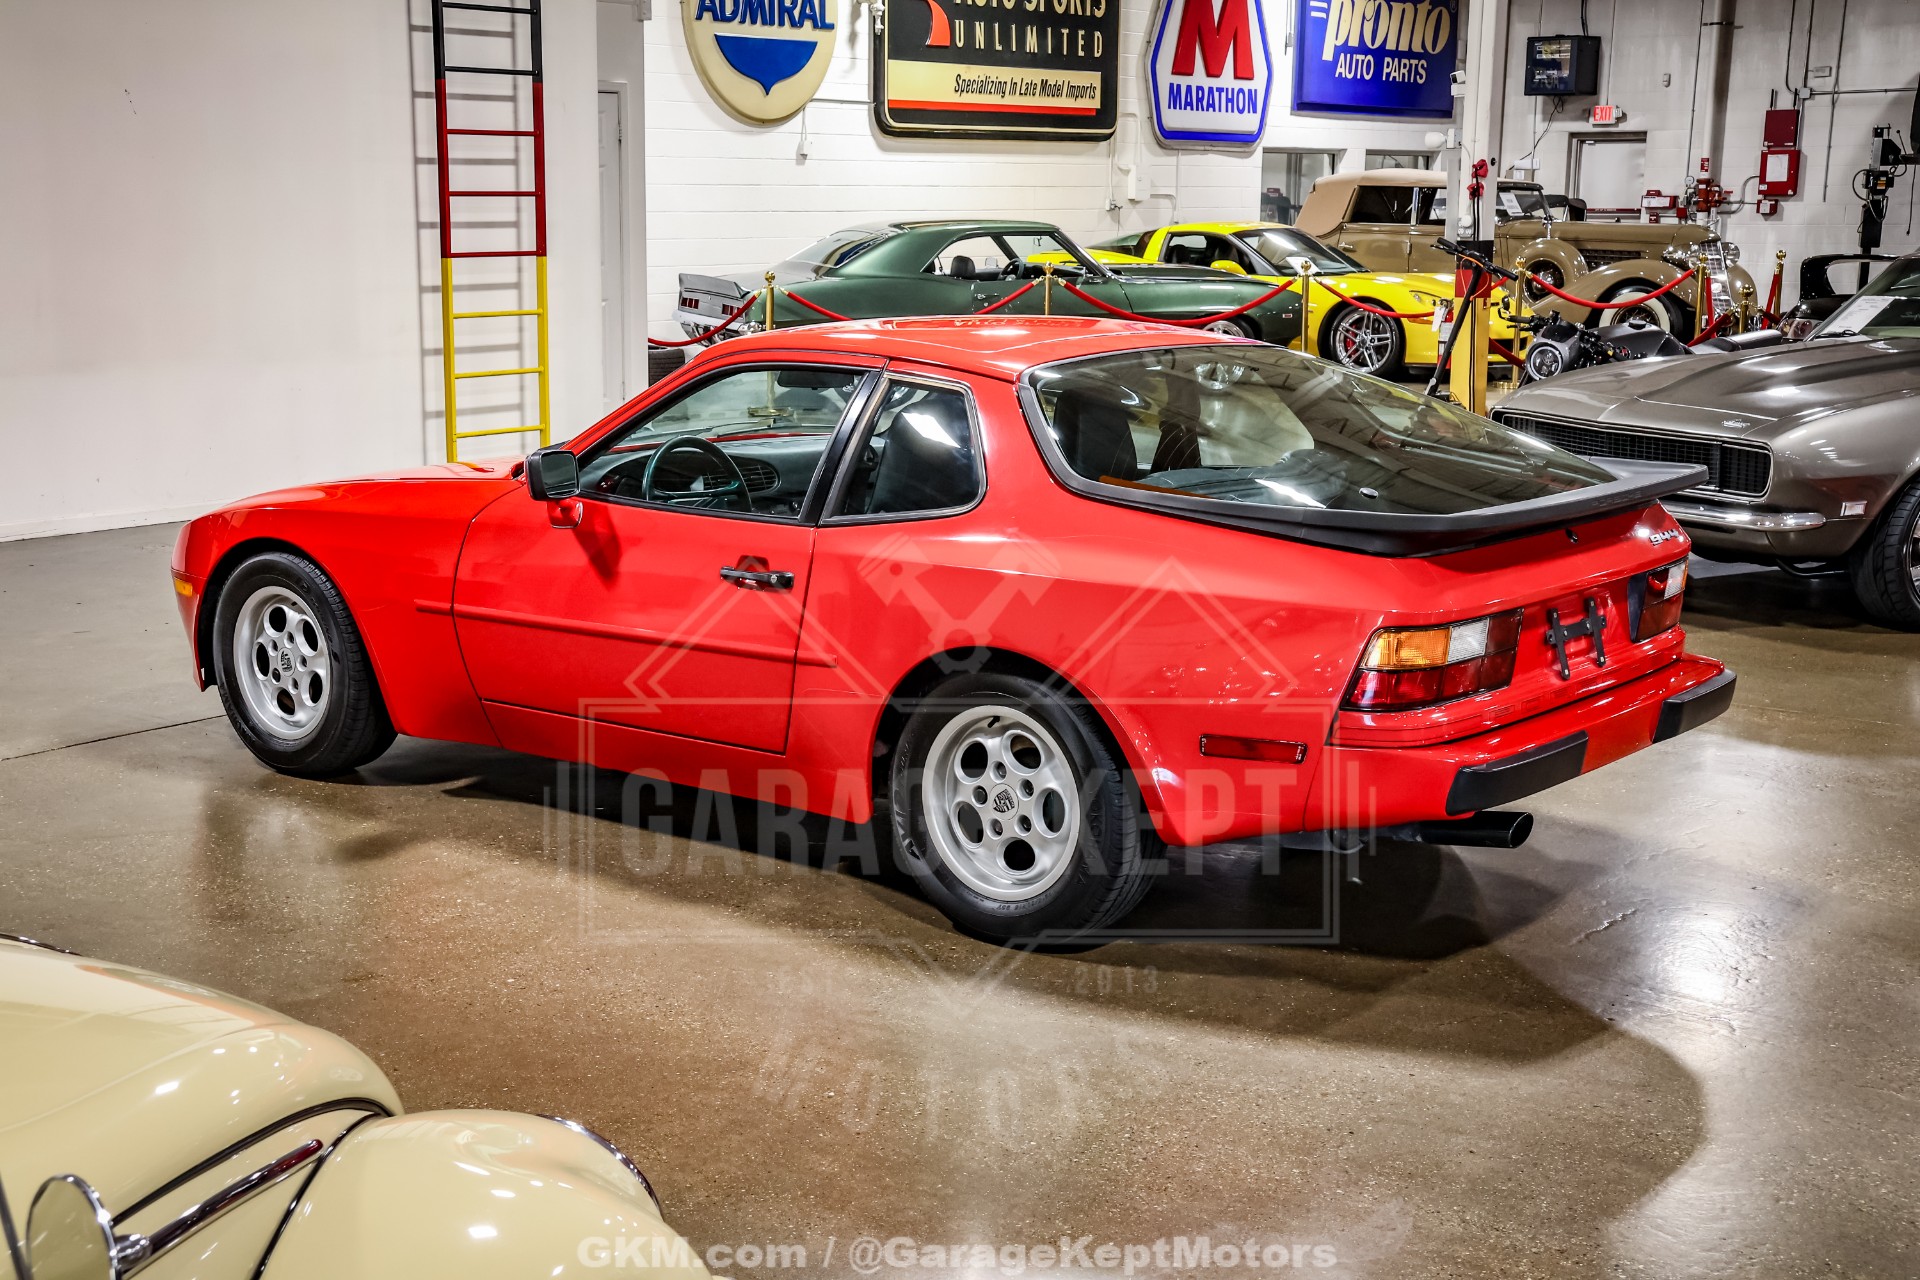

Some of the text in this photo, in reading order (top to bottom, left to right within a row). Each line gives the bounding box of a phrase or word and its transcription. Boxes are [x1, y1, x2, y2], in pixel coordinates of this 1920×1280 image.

[695, 0, 835, 30] ADMIRAL
[1322, 0, 1451, 61] pronto
[954, 19, 1103, 58] UNLIMITED
[1335, 52, 1427, 85] AUTO PARTS
[954, 73, 1097, 101] Specializing In Late Model Imports
[1168, 82, 1257, 114] MARATHON
[1593, 106, 1613, 122] EXIT
[1648, 528, 1680, 547] 944
